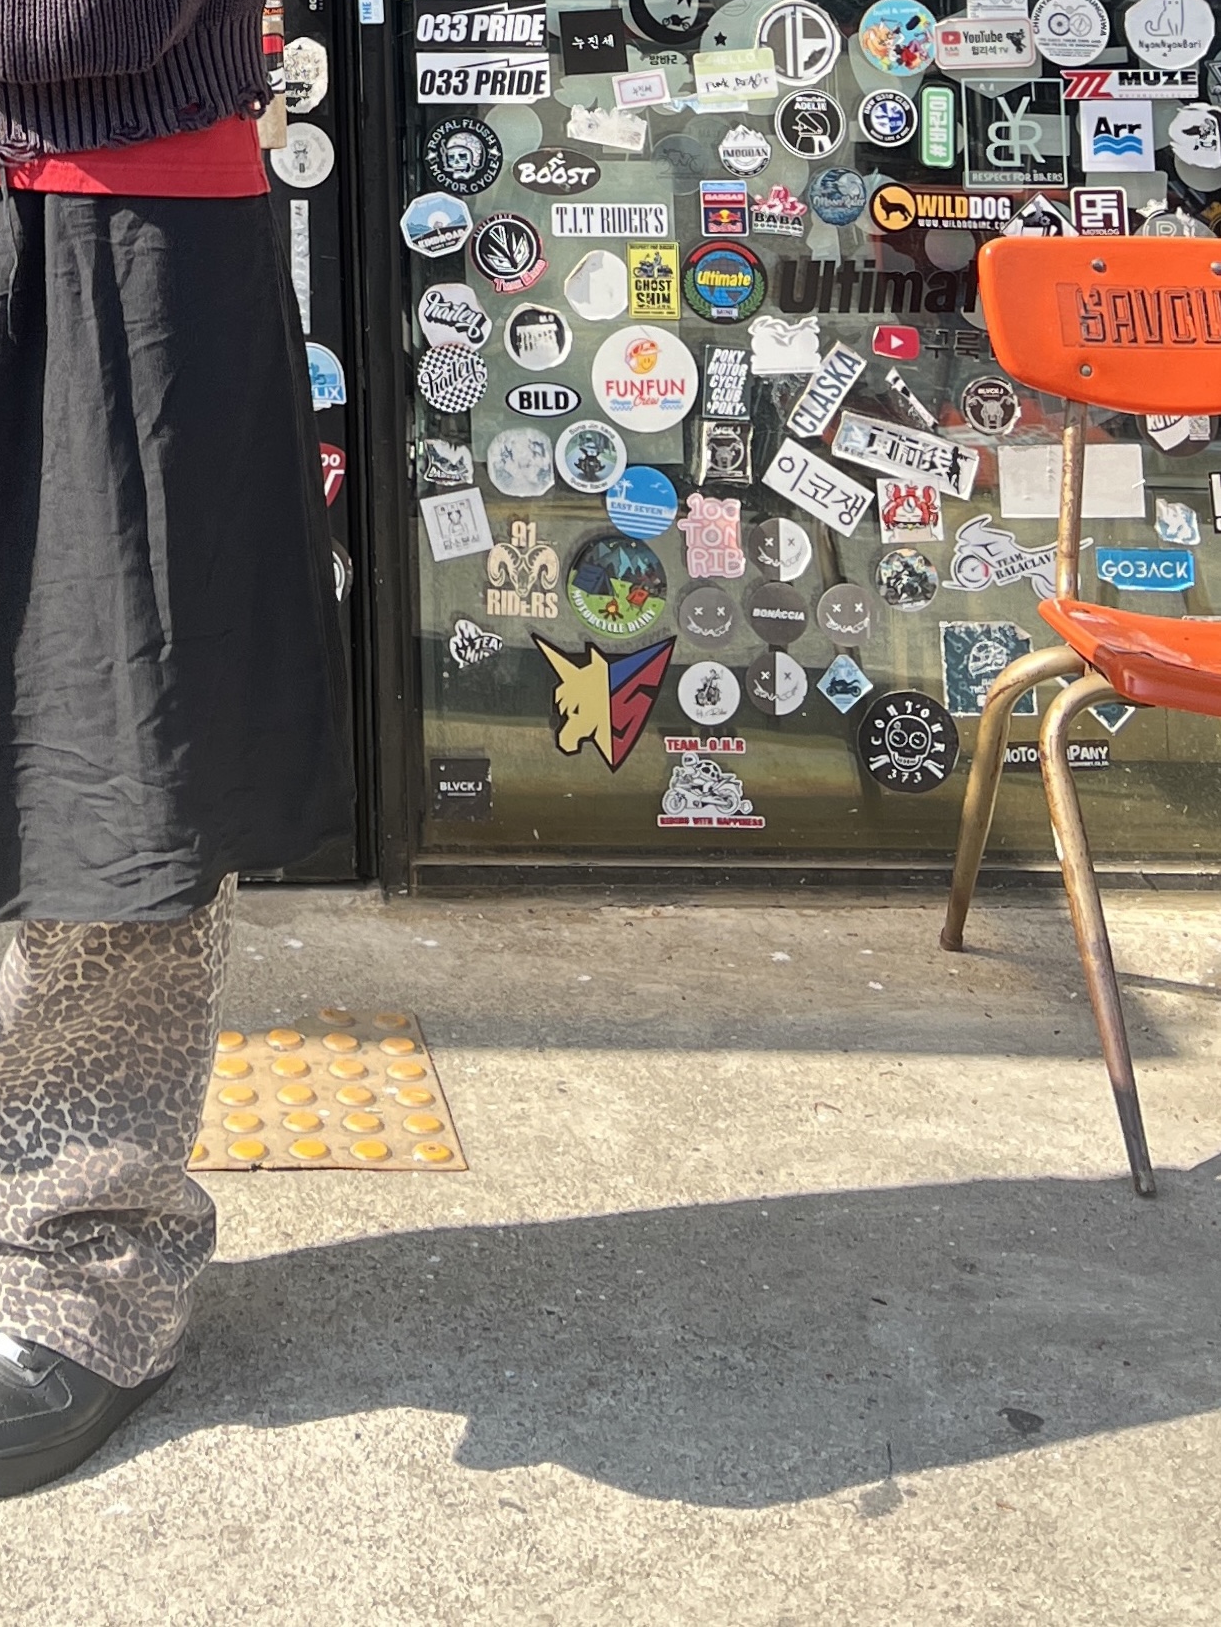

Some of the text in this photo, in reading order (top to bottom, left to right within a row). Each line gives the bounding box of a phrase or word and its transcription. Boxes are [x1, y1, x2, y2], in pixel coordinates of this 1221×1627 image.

[361, 5, 371, 21] THE
[416, 13, 546, 42] 033 PRIDE
[962, 30, 1002, 43] YouTube
[571, 34, 614, 49] 누진세
[419, 70, 547, 96] 033 PRIDE
[1118, 71, 1197, 86] MUZE
[1094, 117, 1142, 138] Arr
[518, 161, 596, 184] BOOST
[917, 196, 1011, 220] WILDDOG
[555, 206, 664, 235] T.I.T RIDER'S
[635, 280, 672, 292] GHOST
[697, 271, 752, 287] Ultimate
[636, 292, 671, 306] SHIN
[713, 348, 746, 364] POKY
[708, 362, 747, 376] MOTOR
[606, 379, 685, 397] FUNFUN
[709, 375, 746, 390] CYCLE
[518, 390, 569, 412] BILD
[710, 388, 742, 402] CLUB
[791, 350, 861, 435] CLASKA
[710, 402, 744, 415] POKY
[777, 456, 864, 527] 이코쟁
[610, 502, 664, 516] EAST SEVEN
[511, 521, 537, 547] 91
[681, 524, 741, 548] TON
[689, 545, 745, 576] RIB
[486, 589, 559, 619] RIDERS
[572, 589, 657, 634] MOTORCYCLE DIARY
[753, 607, 805, 622] BONACCIA
